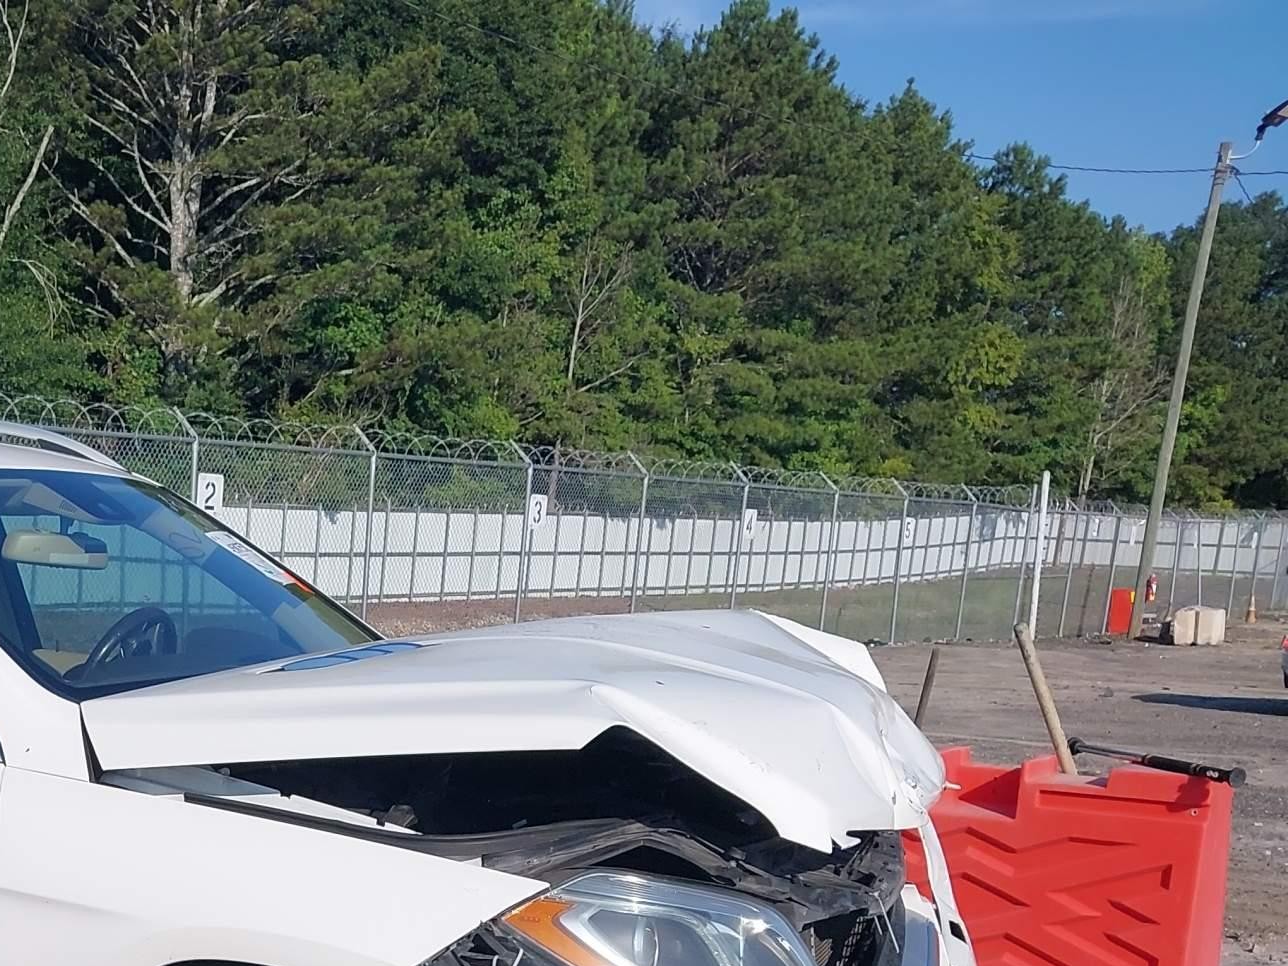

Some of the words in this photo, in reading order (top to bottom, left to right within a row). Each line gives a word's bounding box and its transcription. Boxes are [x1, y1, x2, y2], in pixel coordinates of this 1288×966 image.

[204, 481, 216, 510] 2
[533, 501, 542, 524] 3
[746, 513, 753, 535] 4
